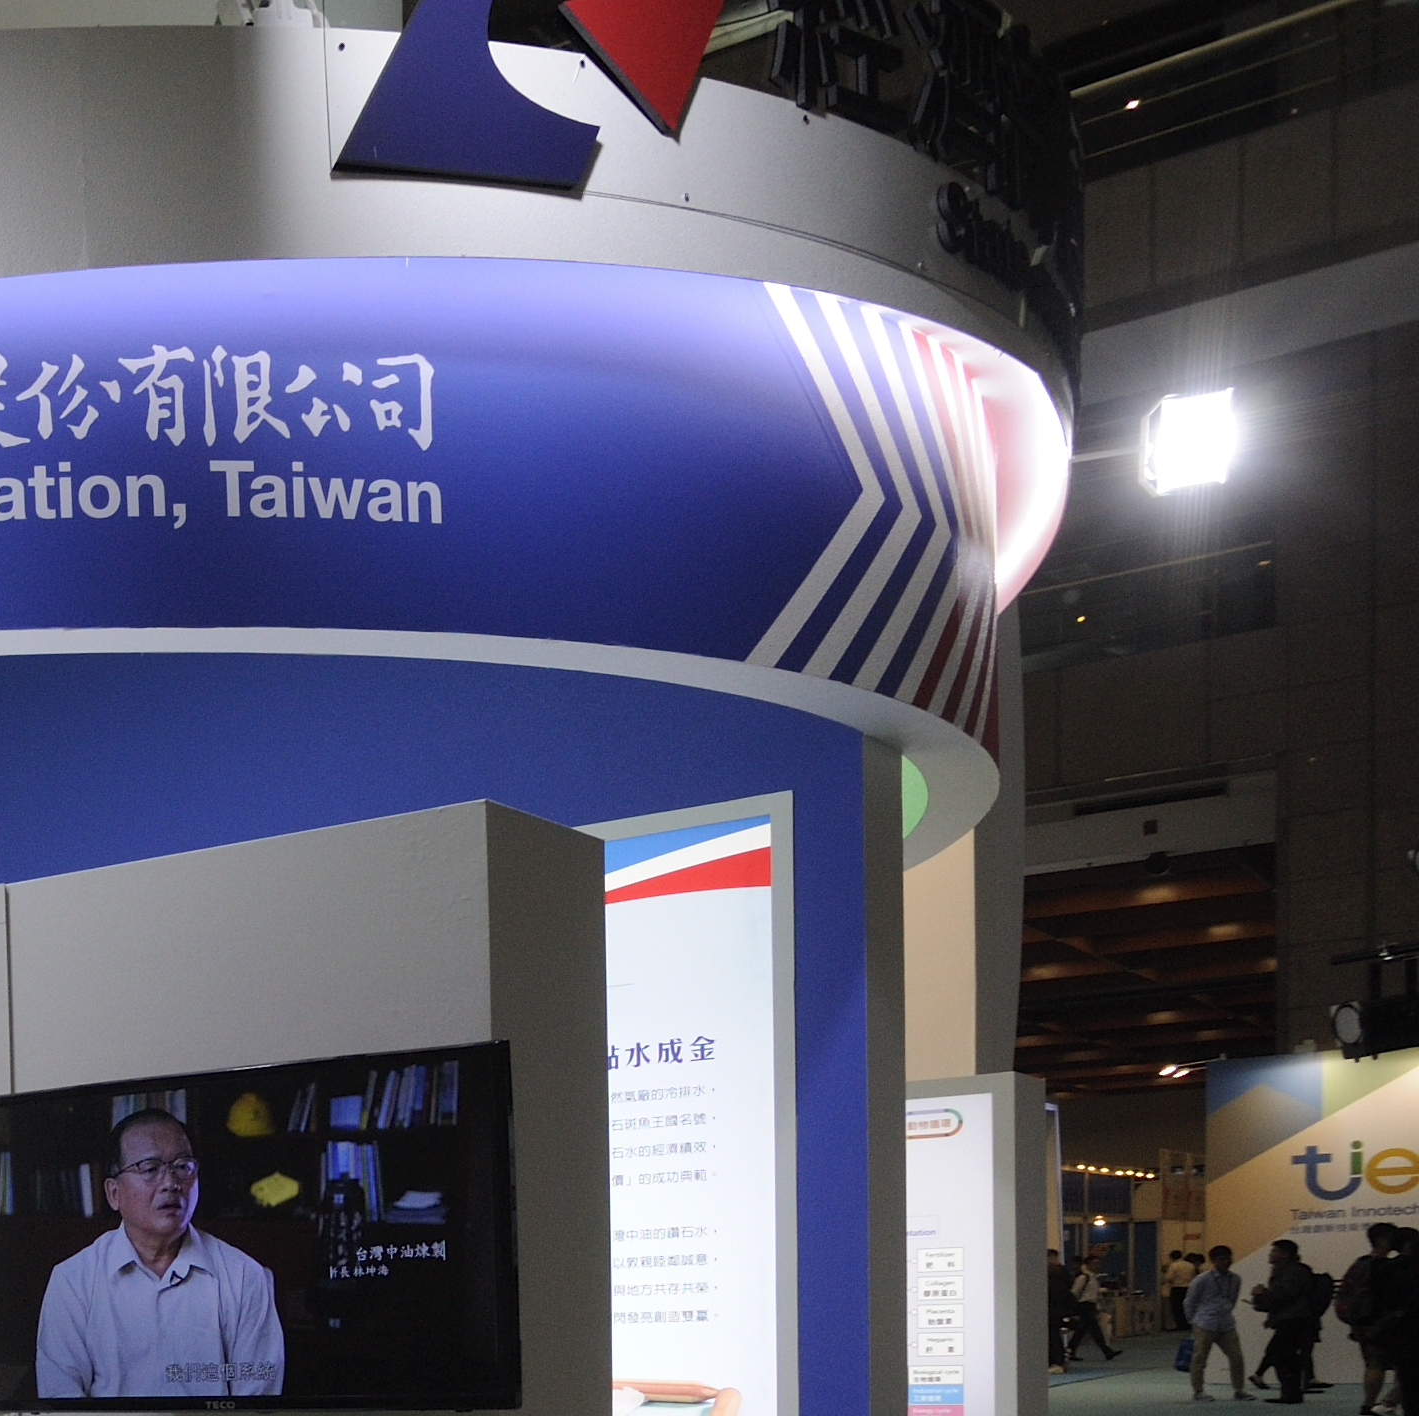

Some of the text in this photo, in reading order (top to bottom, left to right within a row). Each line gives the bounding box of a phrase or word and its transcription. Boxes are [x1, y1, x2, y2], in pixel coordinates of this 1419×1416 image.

[208, 459, 444, 525] Taiwan
[1291, 1140, 1419, 1201] tie
[1289, 1207, 1346, 1221] Taiwan
[925, 1251, 956, 1259] Fertilizer
[925, 1280, 956, 1288] Collagen
[927, 1336, 955, 1344] Heparin
[165, 1361, 277, 1383] 我們這個系統
[204, 1400, 236, 1410] TECO
